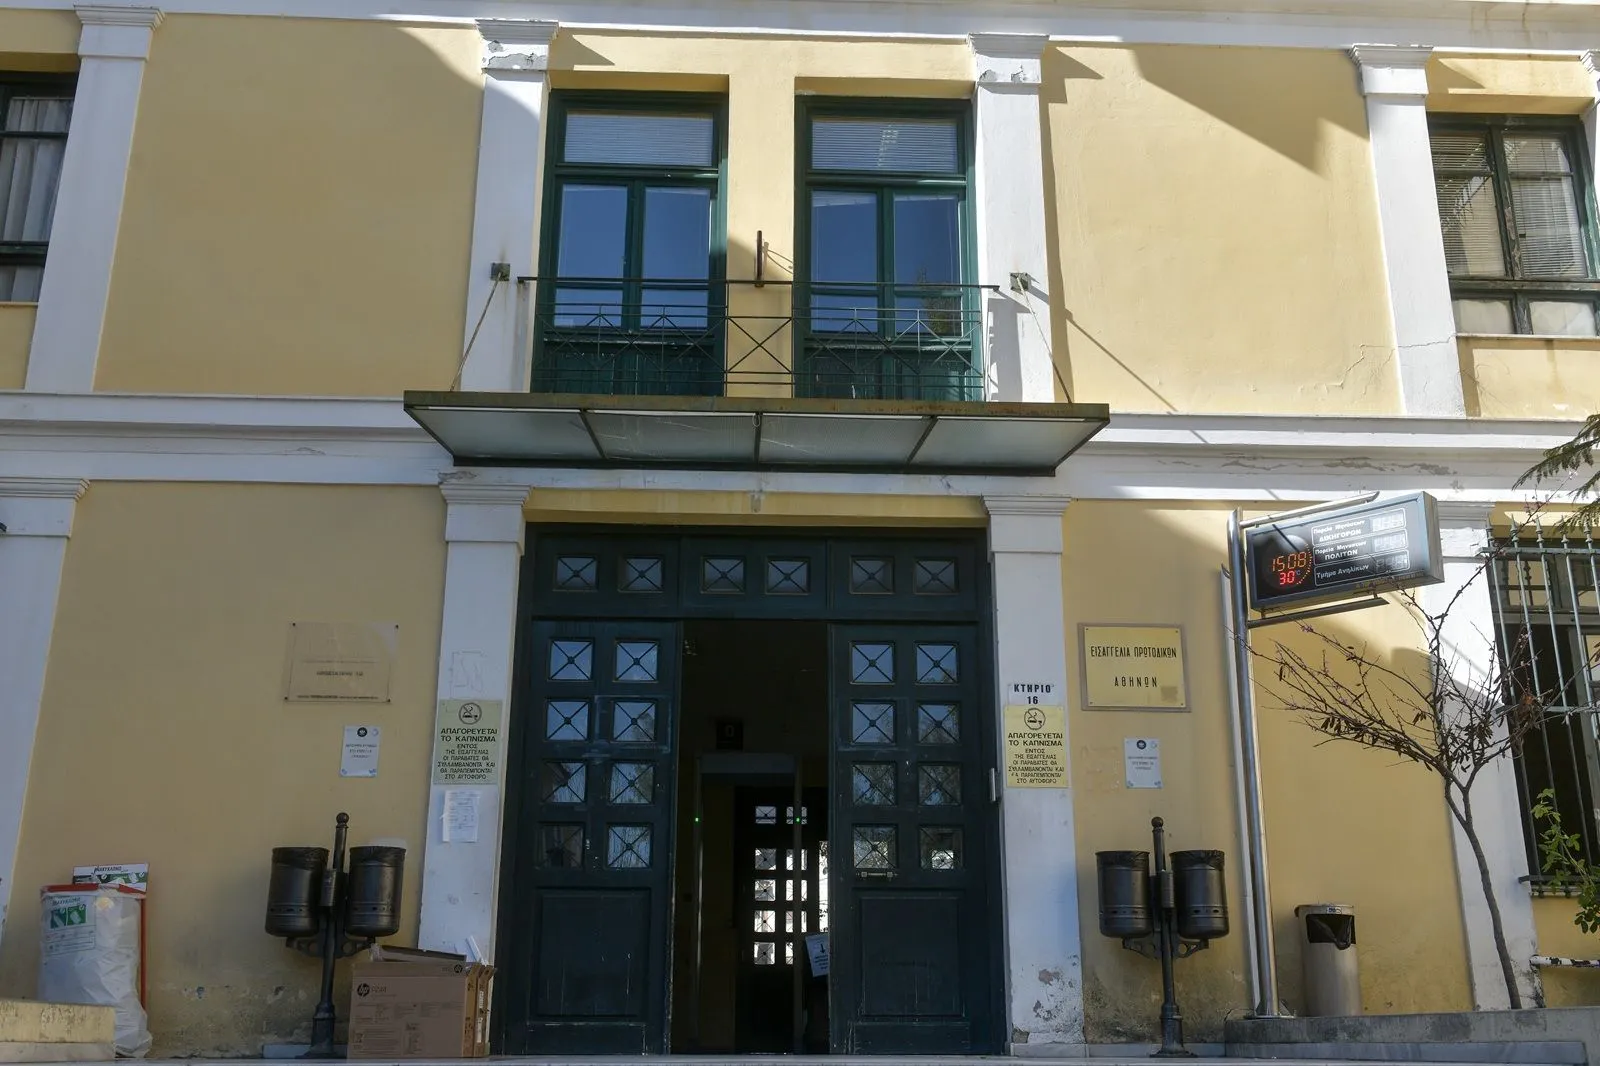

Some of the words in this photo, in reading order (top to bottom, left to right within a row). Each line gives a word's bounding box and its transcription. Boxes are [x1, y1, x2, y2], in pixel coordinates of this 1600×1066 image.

[1319, 529, 1362, 542] ΔΙΚΗΓΟΡΩΝ
[1325, 548, 1359, 561] ΠΟΛΙΤΩΝ
[1279, 570, 1296, 585] 30
[1090, 645, 1131, 657] ΕΙΣΑΓΓΕΛΙΑ
[1133, 646, 1177, 658] ΠΡΩΤΟΔΙΚΩΝ
[1013, 683, 1051, 693] ΚΤΗΡΙΟ
[1114, 676, 1158, 688] ΑΘΗΝΩΝ
[1027, 695, 1039, 705] 16
[440, 727, 498, 735] ΑΠΑΓΟΡΕΥΕΤΑΙ
[1008, 739, 1020, 747] ΤΟ
[1023, 739, 1063, 747] ΚΑΠΝΙΣΜΑ
